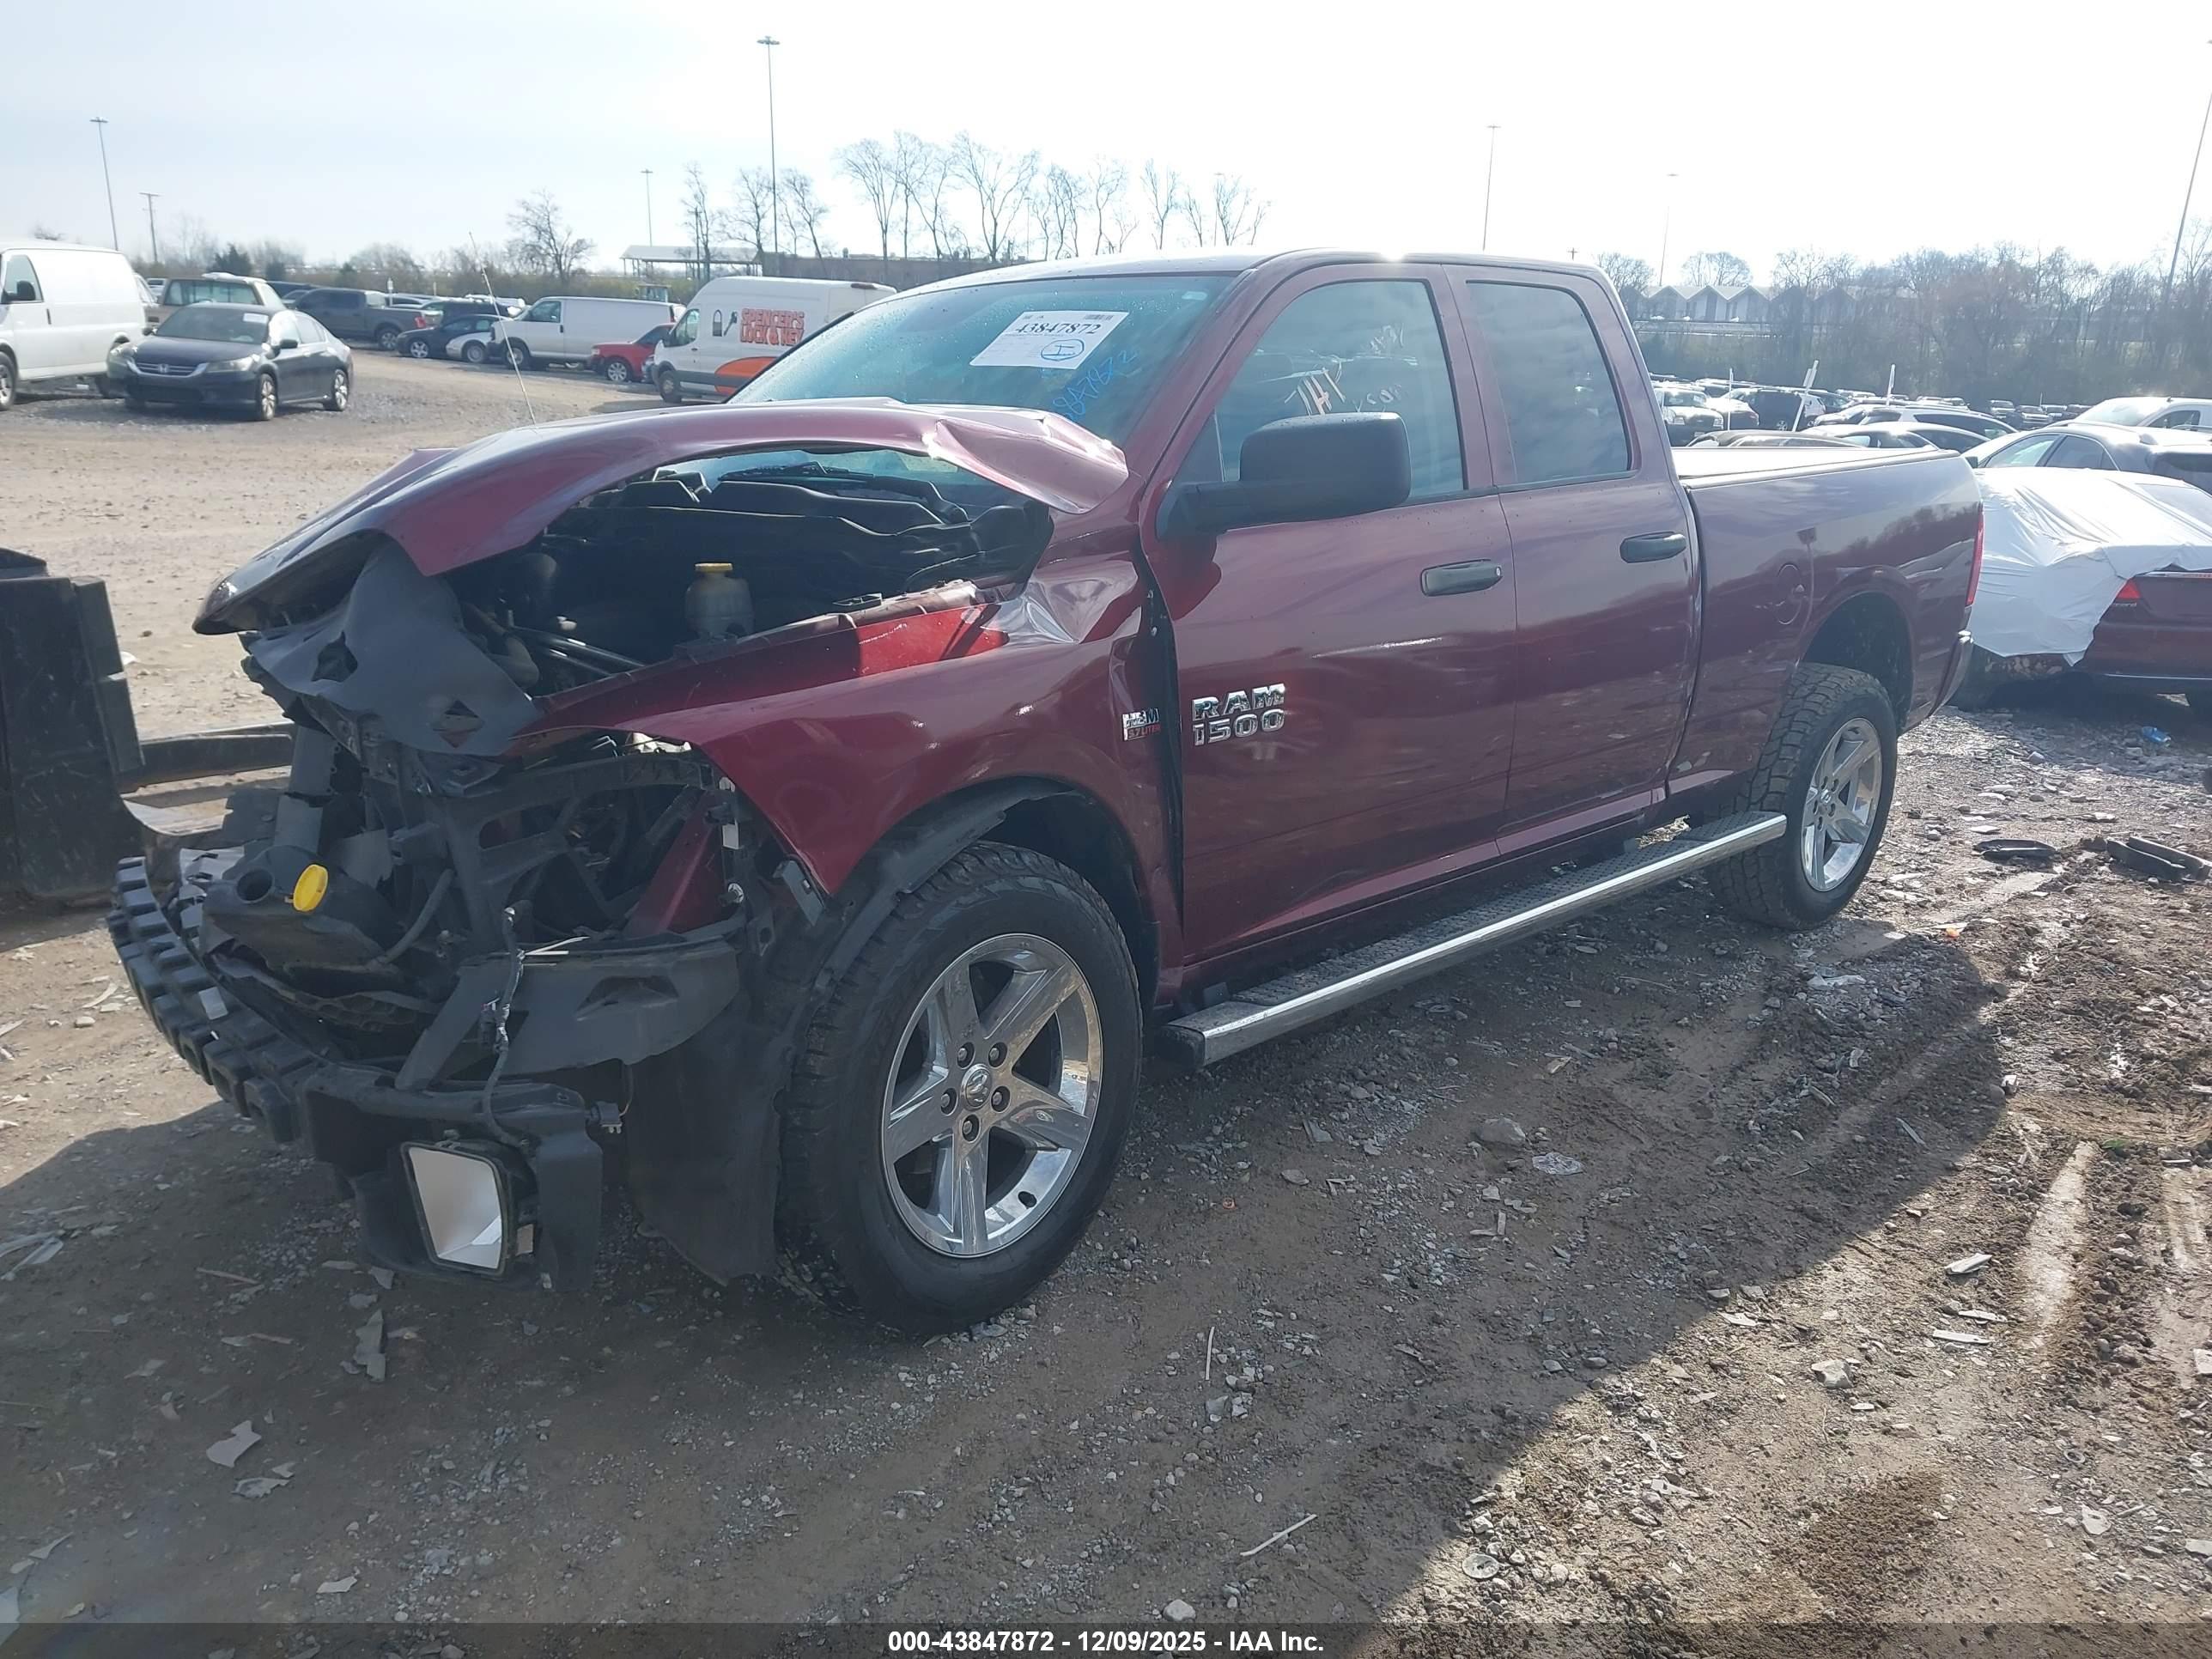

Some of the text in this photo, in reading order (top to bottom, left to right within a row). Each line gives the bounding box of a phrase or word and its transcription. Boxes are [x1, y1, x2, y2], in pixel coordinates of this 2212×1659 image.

[742, 308, 805, 330] SPENCER'S
[1015, 322, 1103, 334] 43847872
[1192, 683, 1285, 721] RAM
[1193, 708, 1285, 745] 1500
